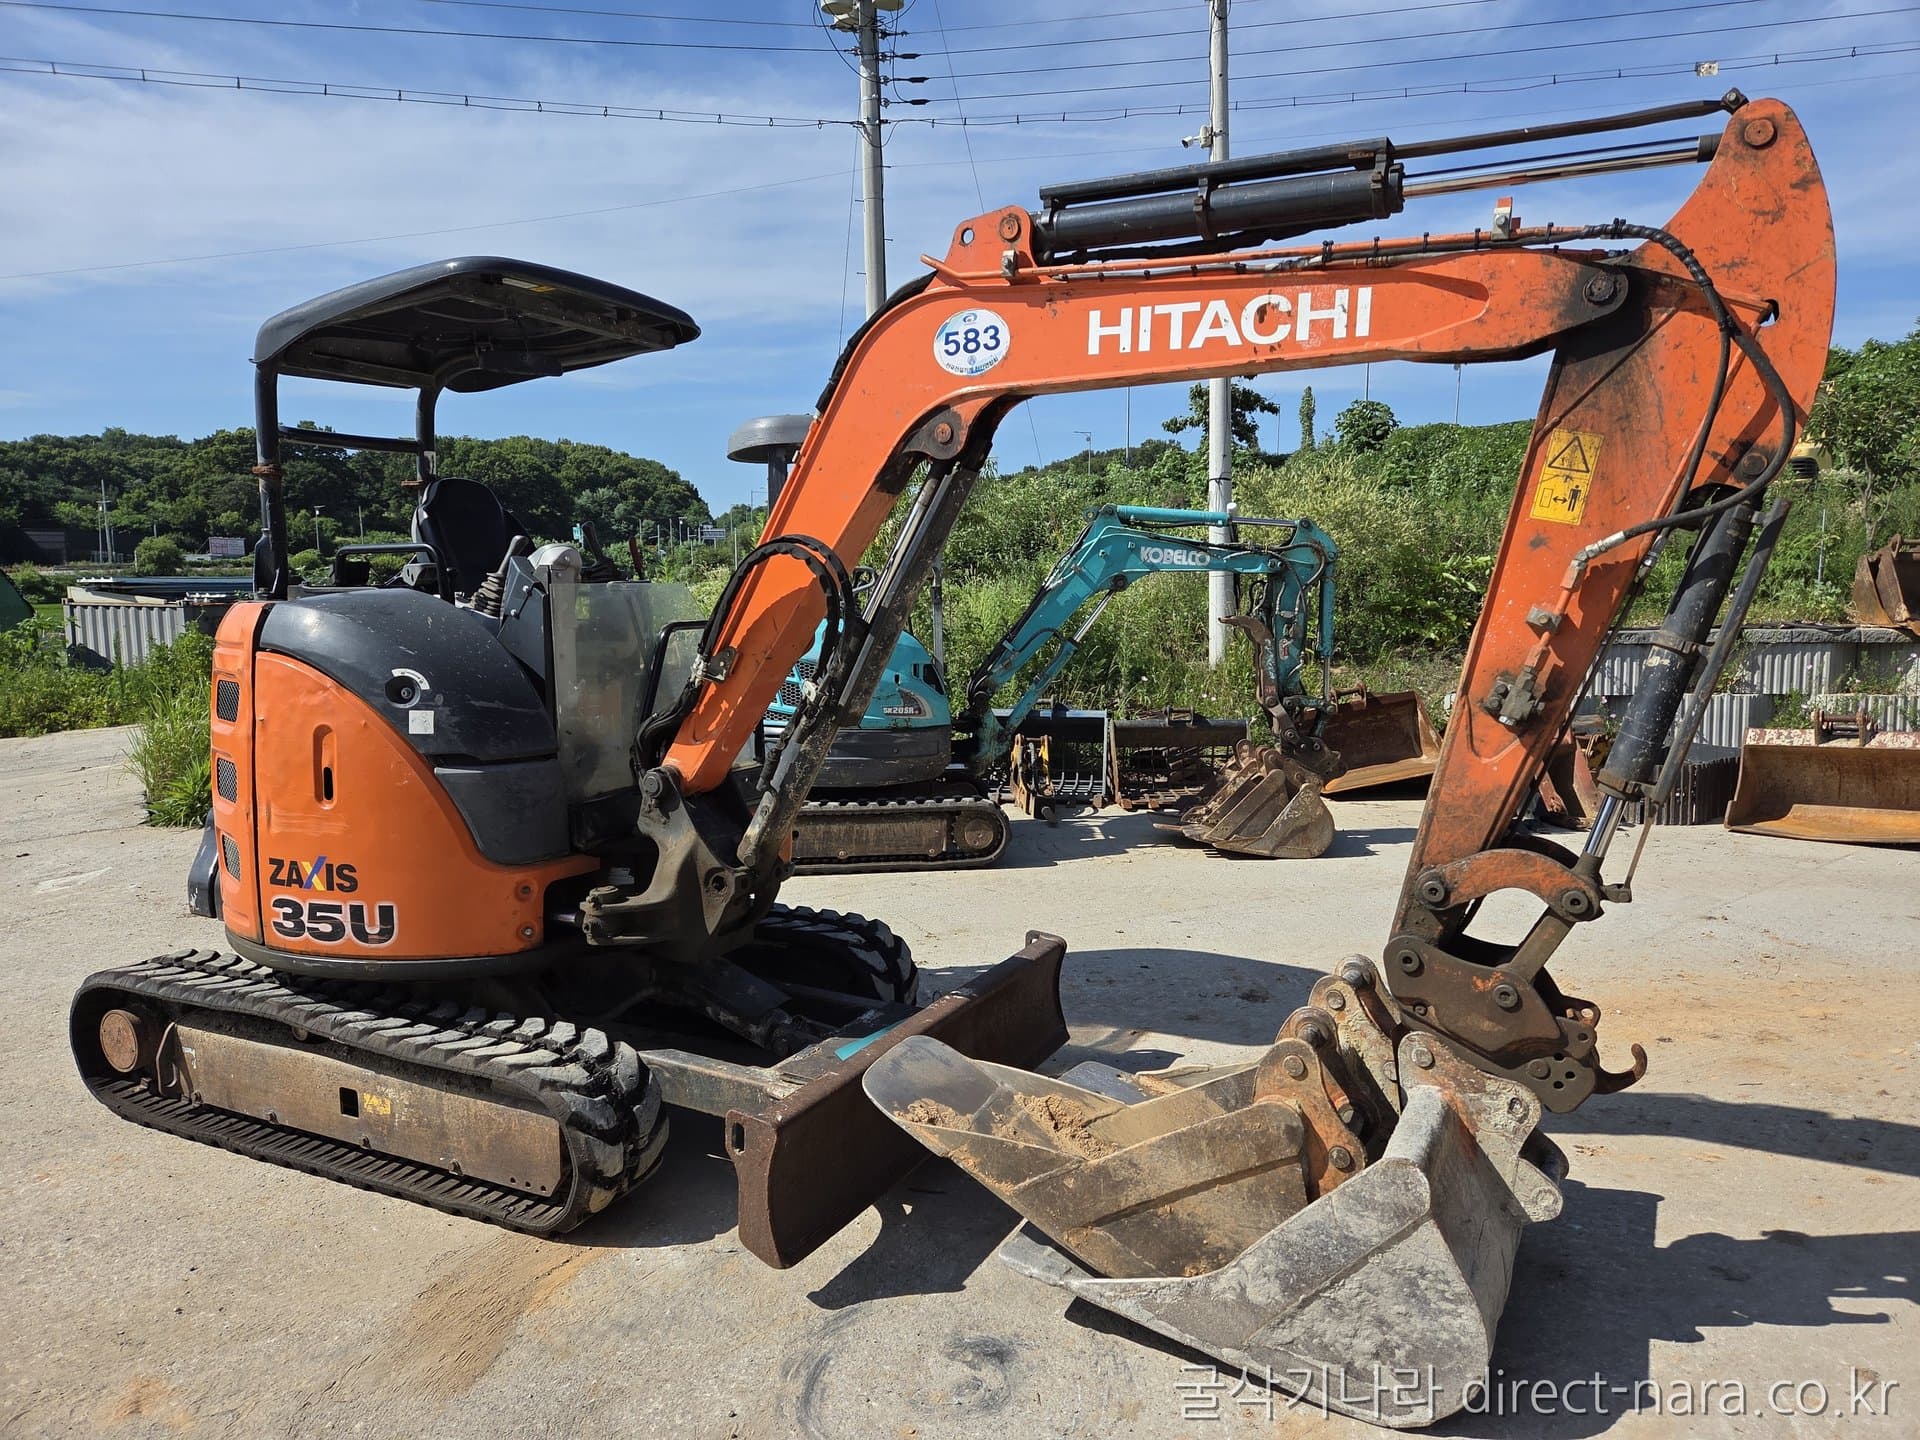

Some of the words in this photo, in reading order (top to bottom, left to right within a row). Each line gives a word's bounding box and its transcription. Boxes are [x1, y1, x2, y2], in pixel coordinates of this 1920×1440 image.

[1087, 287, 1373, 356] HITACHI
[943, 325, 1001, 356] 583
[1140, 546, 1211, 567] KOBELCO
[268, 856, 359, 893] ZAXIS
[271, 896, 397, 946] 35U
